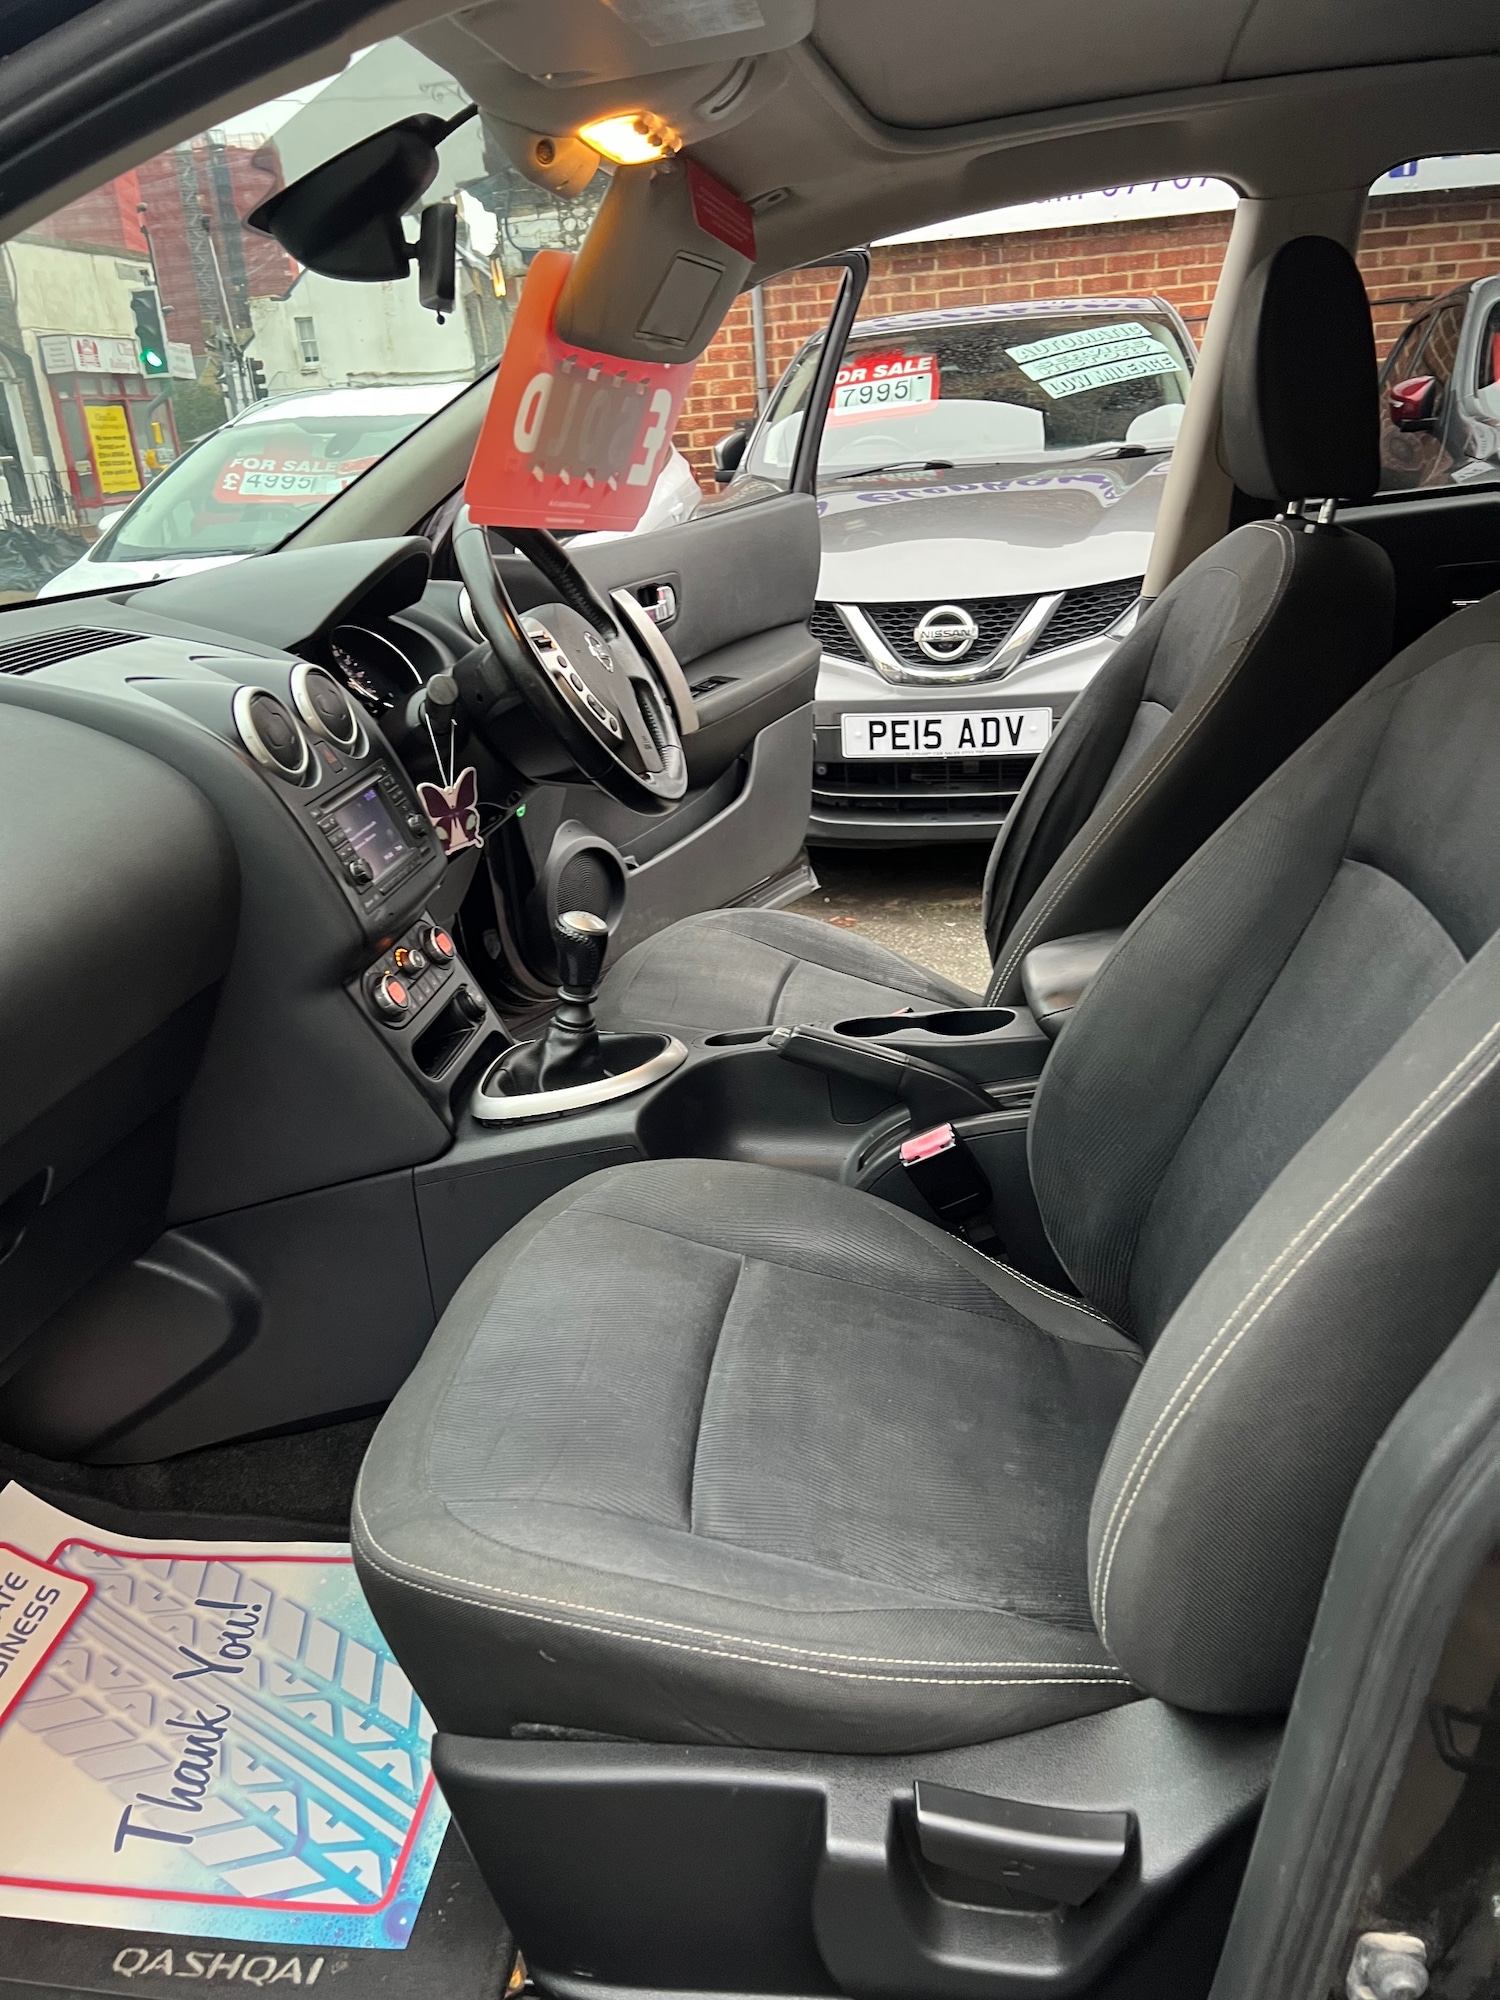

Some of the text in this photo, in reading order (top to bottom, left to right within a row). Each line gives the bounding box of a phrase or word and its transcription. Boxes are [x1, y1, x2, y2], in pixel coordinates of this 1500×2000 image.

[1015, 325, 1143, 360] AUTOMATIC
[1033, 340, 1148, 368] SERVICE
[835, 356, 933, 385] OR SALE
[1039, 346, 1152, 376] HISTORY
[1047, 357, 1176, 396] LOW MILEAGE
[842, 380, 909, 407] 7995
[229, 457, 277, 471] FOR
[281, 460, 338, 473] SALE
[920, 629, 971, 641] NISSAN
[868, 716, 1025, 751] PE15 ADV
[114, 1597, 264, 1855] Thank You!
[112, 1946, 325, 1987] QASHQAI
